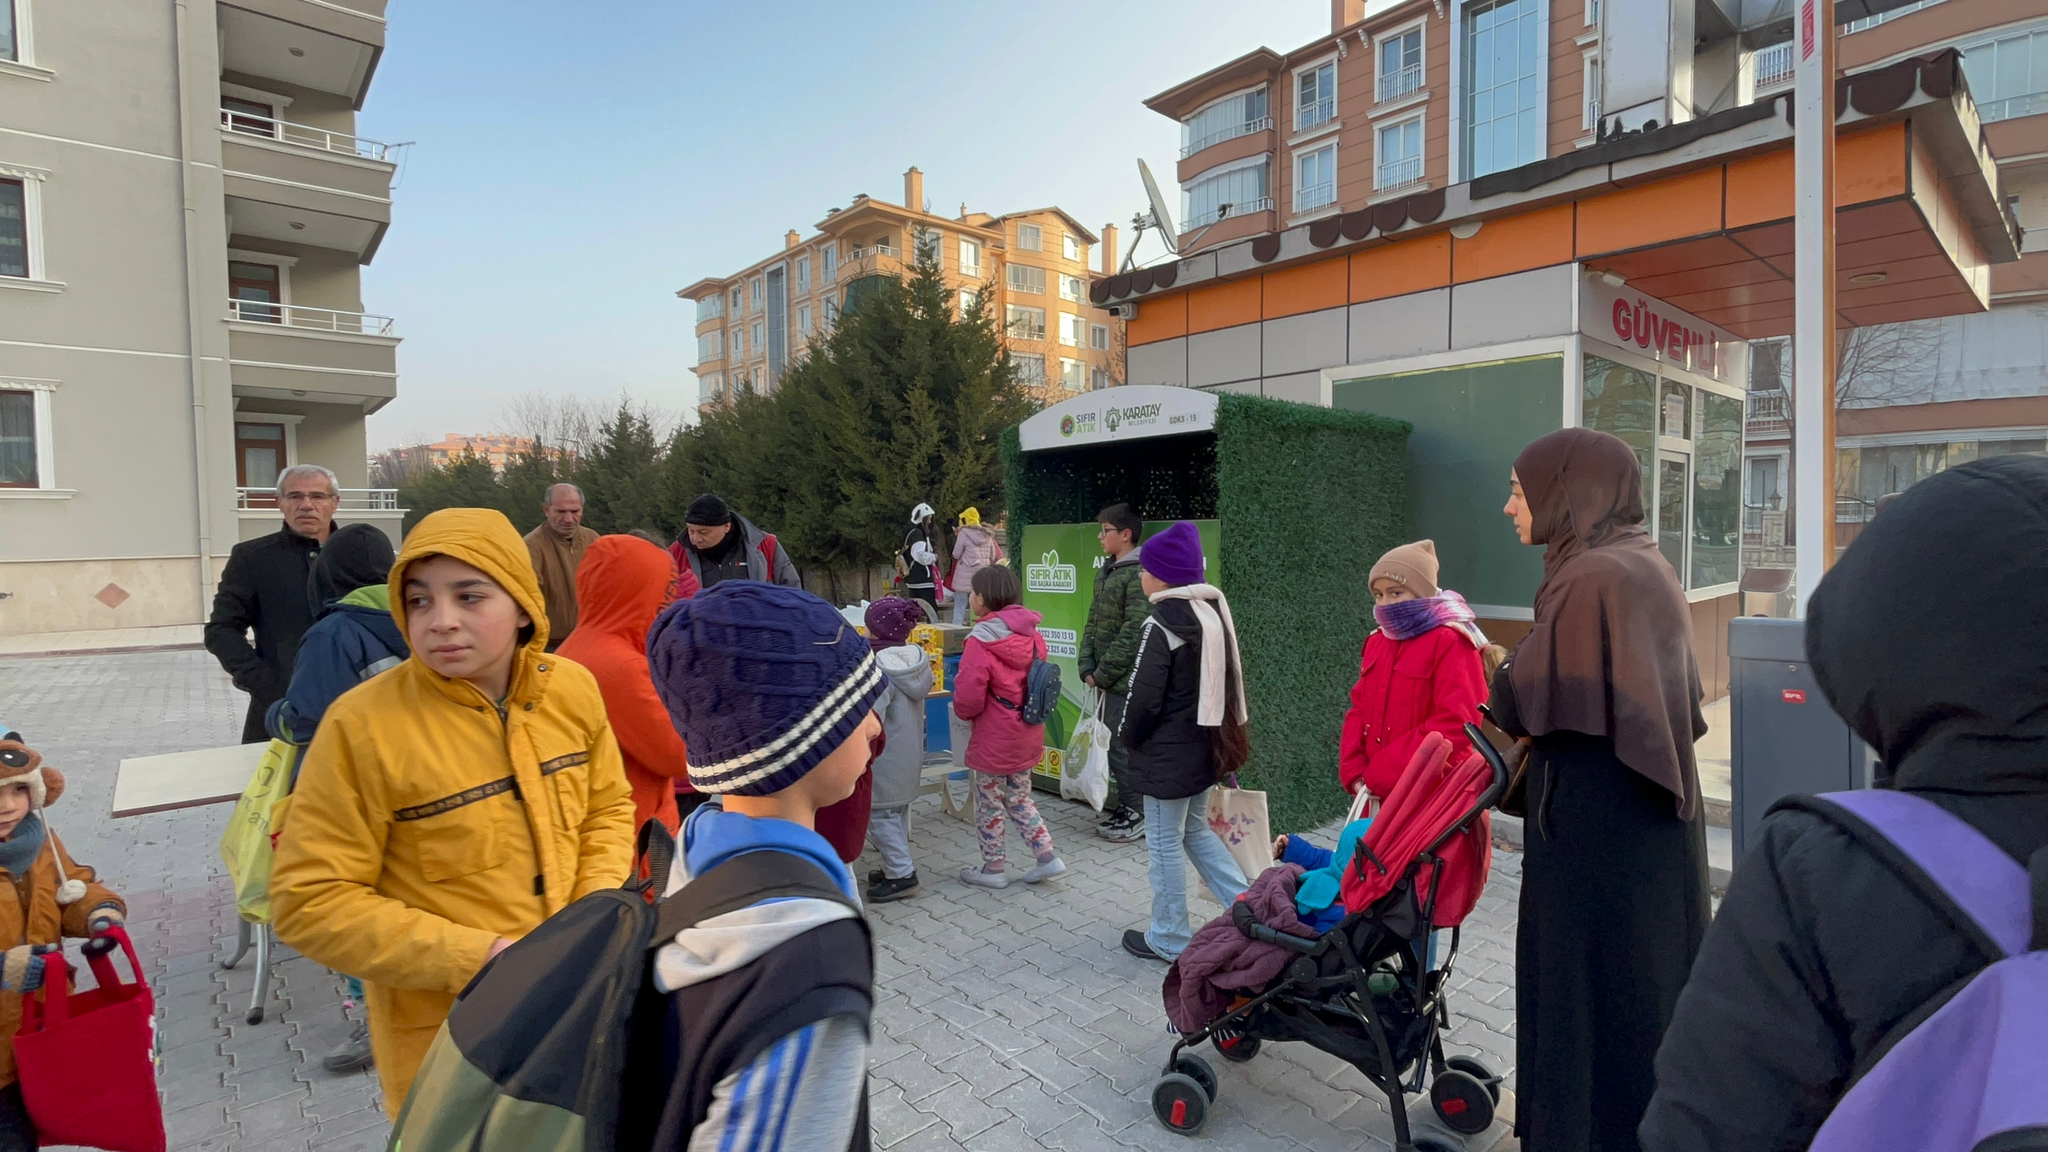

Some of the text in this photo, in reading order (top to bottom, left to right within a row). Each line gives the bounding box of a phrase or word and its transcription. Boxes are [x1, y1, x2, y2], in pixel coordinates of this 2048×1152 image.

[1123, 403, 1162, 421] KARATAY
[1190, 413, 1197, 422] 19
[1076, 412, 1096, 424] SIFIR
[1076, 423, 1096, 434] ATIK
[1030, 569, 1072, 581] SIFIR ATIK
[1061, 632, 1068, 640] 13
[1068, 632, 1074, 641] 13
[1061, 646, 1068, 655] 40
